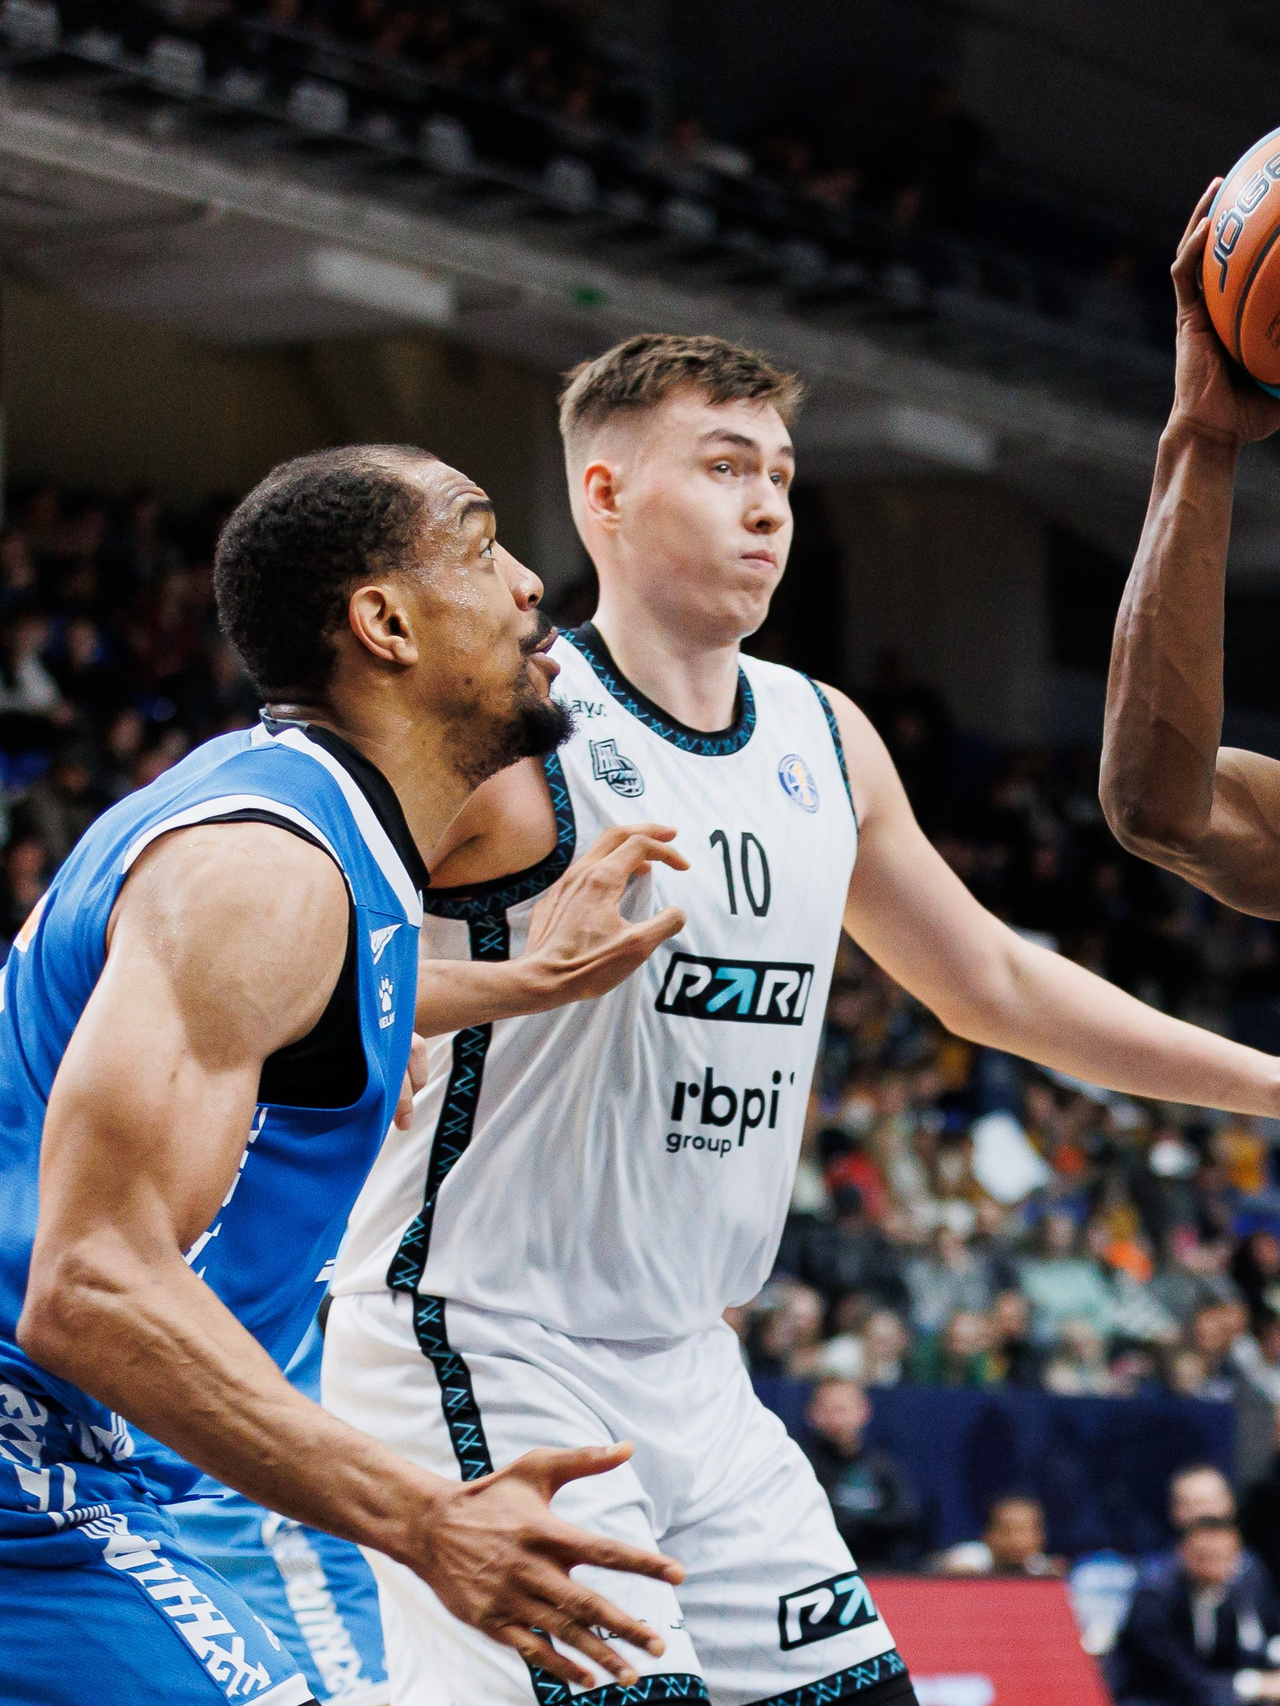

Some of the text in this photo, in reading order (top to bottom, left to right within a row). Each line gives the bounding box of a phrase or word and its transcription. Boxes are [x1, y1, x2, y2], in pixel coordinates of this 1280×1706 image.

[709, 829, 772, 917] 10
[663, 960, 811, 1019] PARI
[666, 1132, 732, 1158] group
